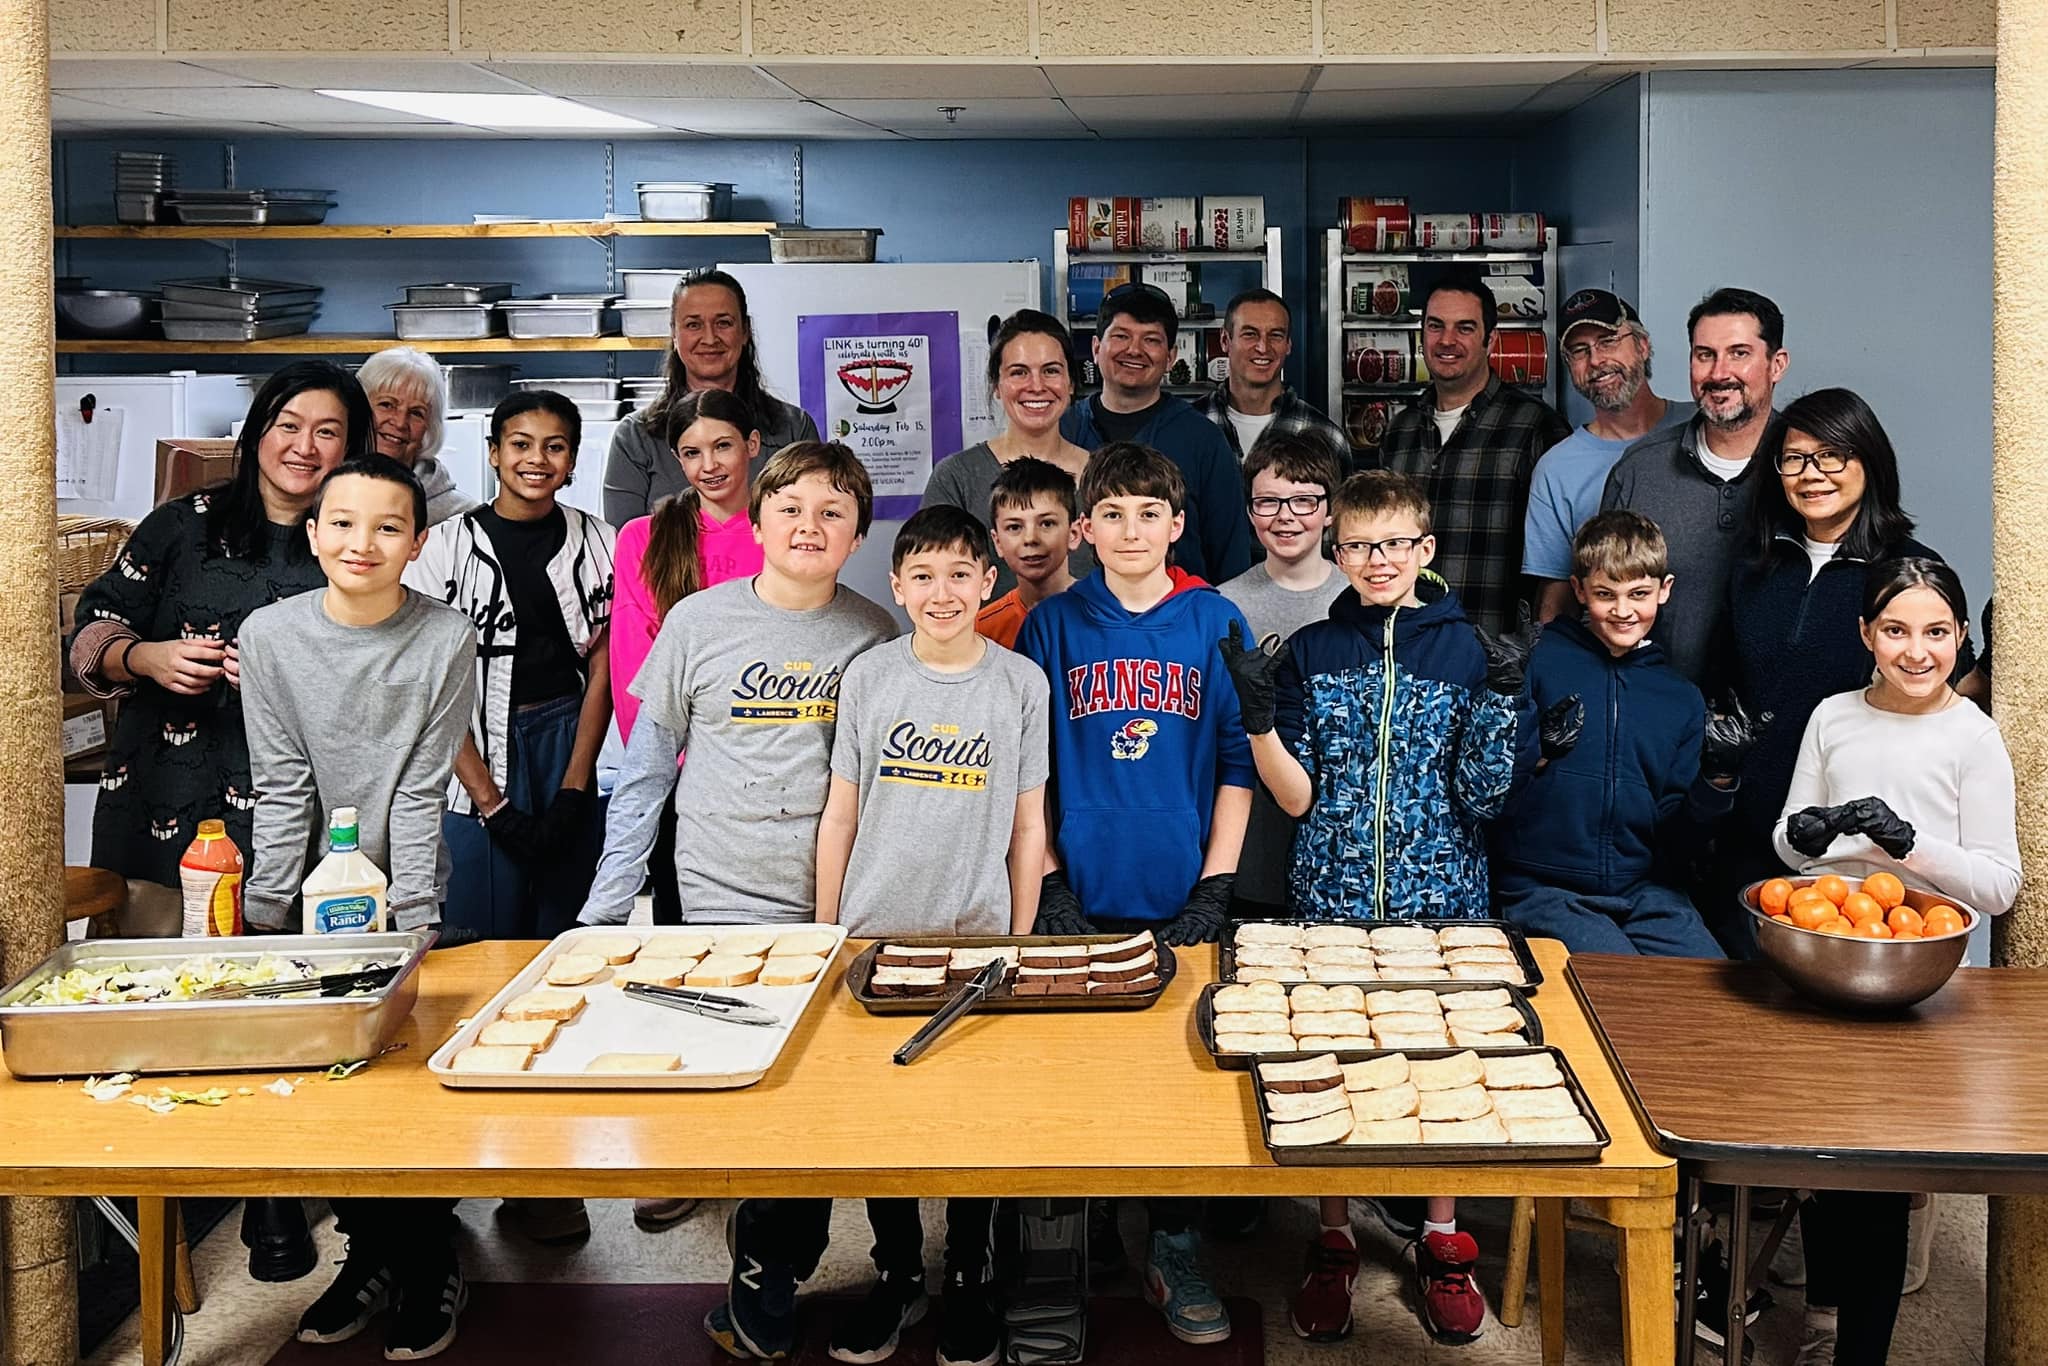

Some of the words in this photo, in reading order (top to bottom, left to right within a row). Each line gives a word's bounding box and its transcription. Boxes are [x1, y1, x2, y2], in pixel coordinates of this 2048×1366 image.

[1236, 208, 1244, 243] HARVEST
[1359, 288, 1368, 311] CHILI
[825, 340, 851, 350] LINK
[855, 341, 864, 349] is
[867, 339, 905, 351] turning
[784, 661, 812, 671] CUB
[731, 660, 841, 701] Scouts
[1068, 659, 1201, 720] KANSAS
[931, 723, 960, 735] CUB
[881, 720, 993, 768] Scouts
[942, 772, 987, 786] 3462
[330, 913, 366, 927] Ranch
